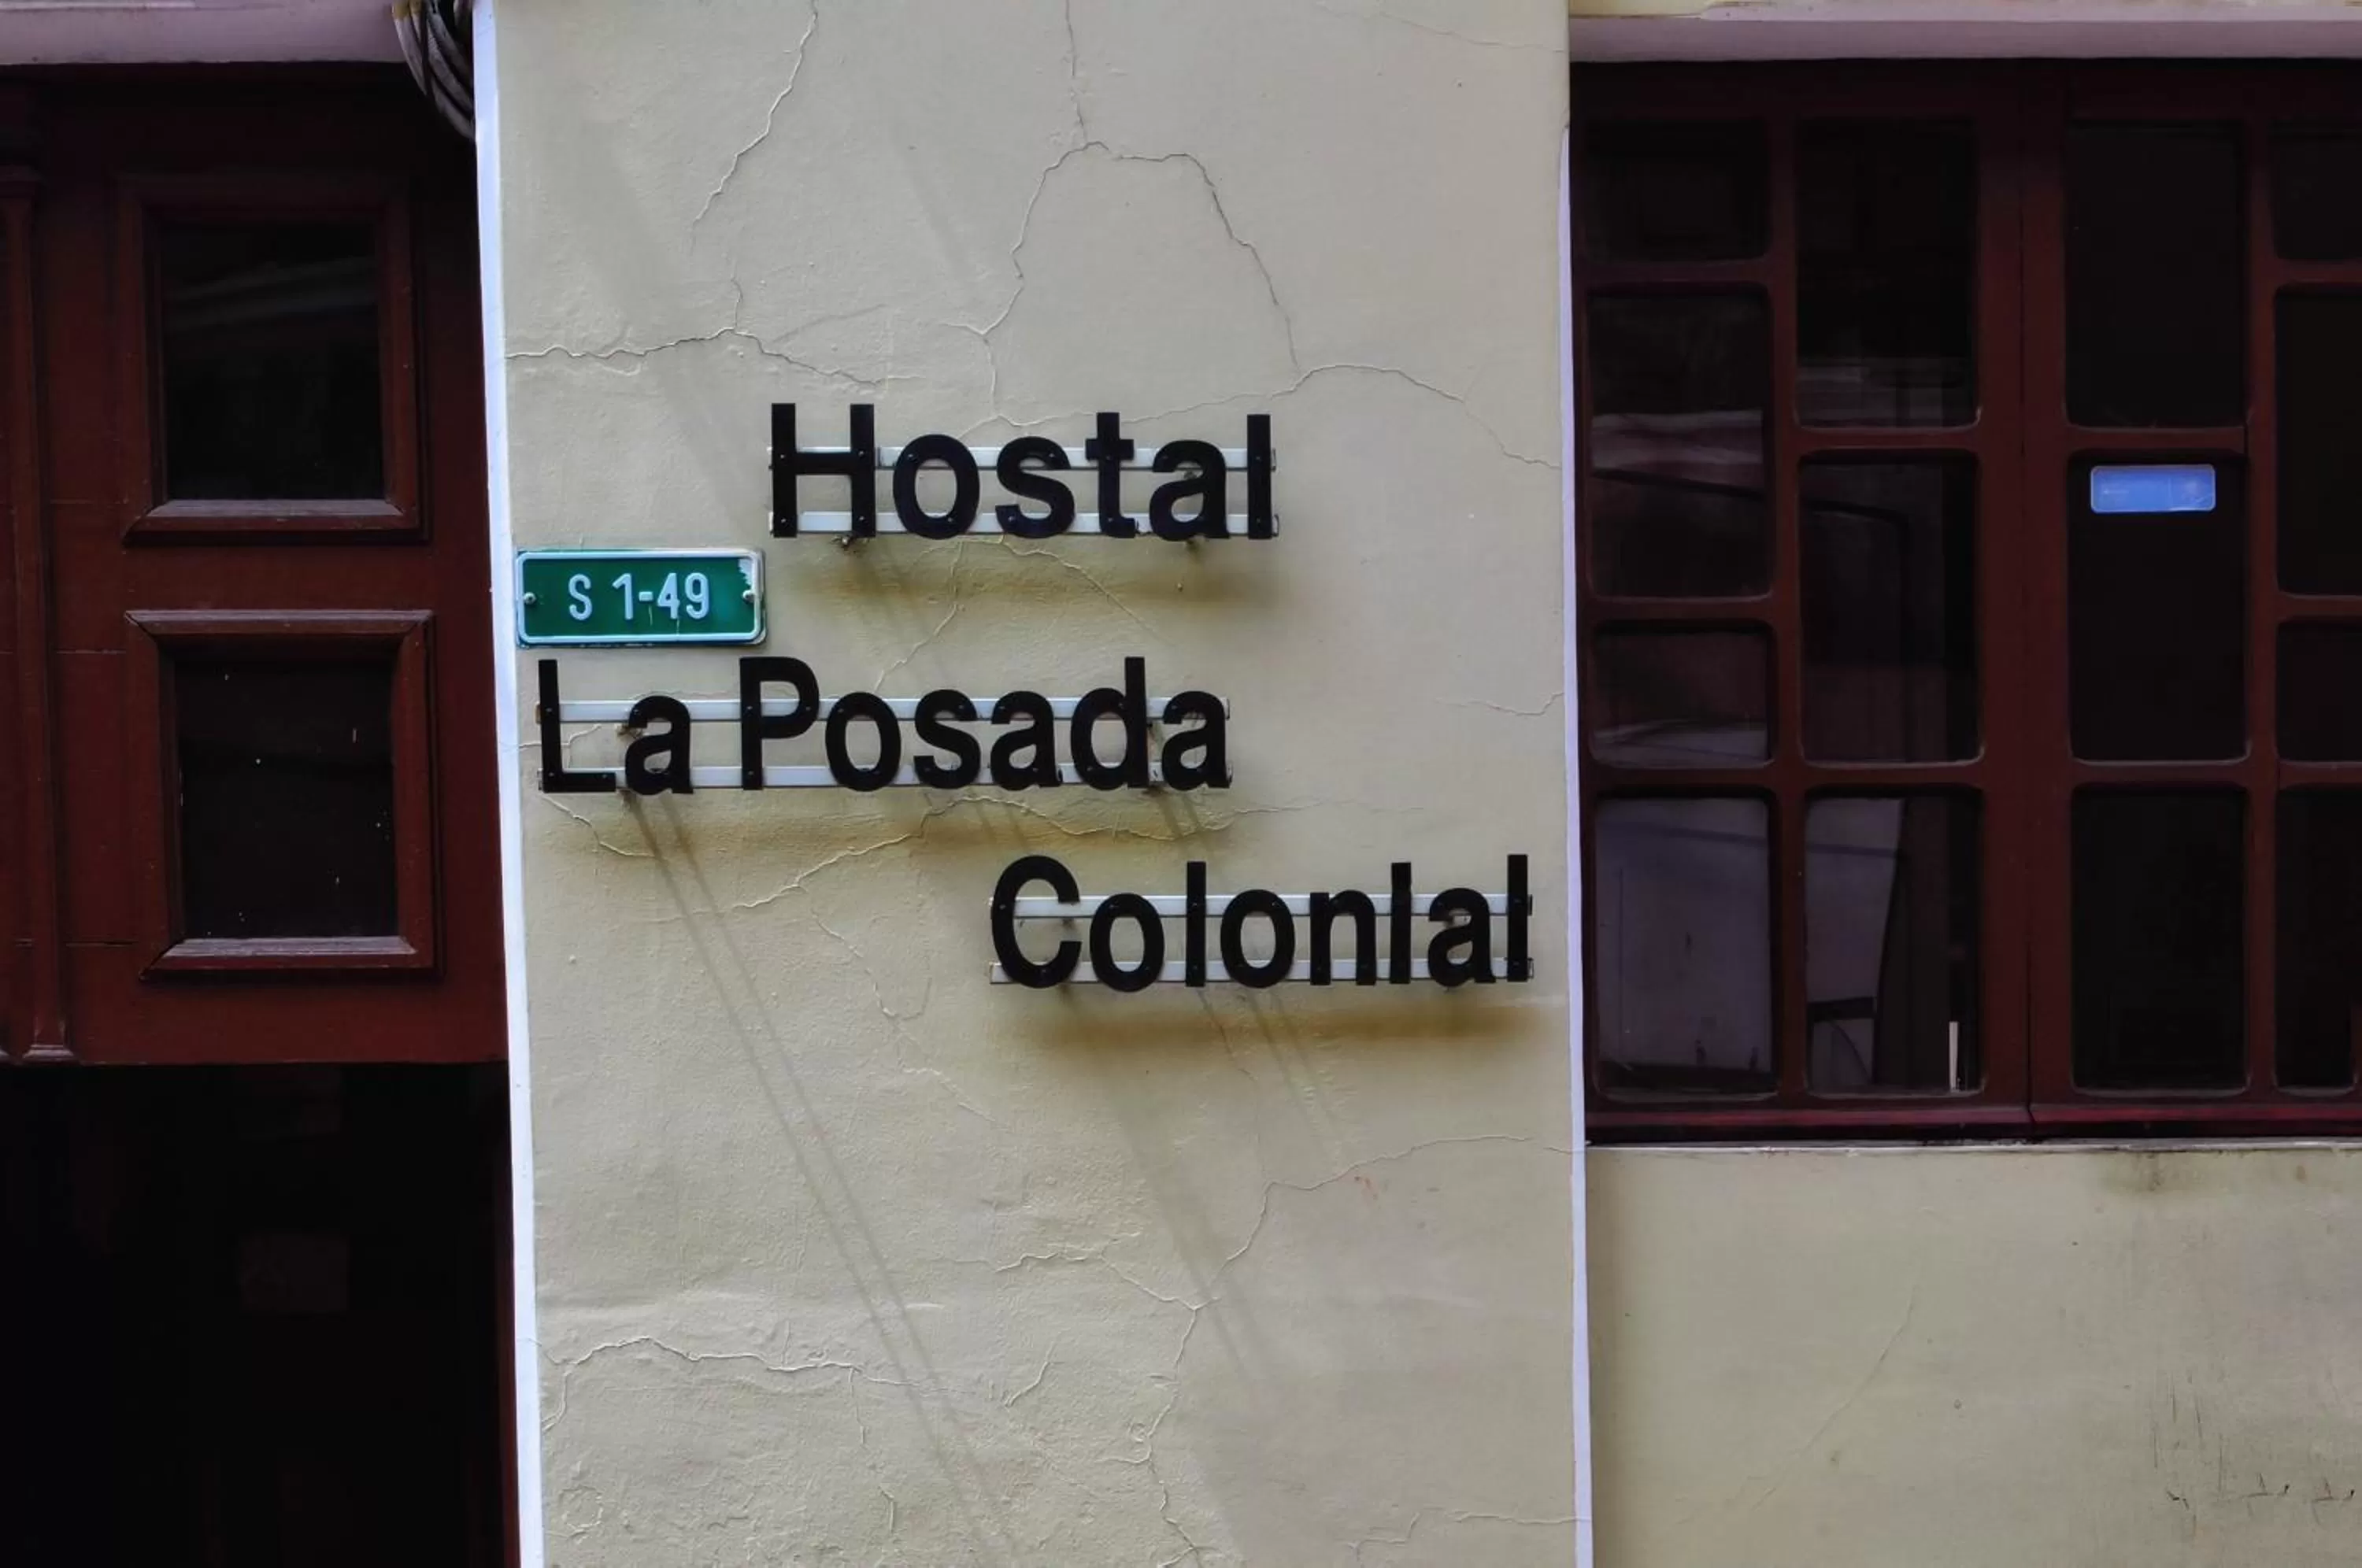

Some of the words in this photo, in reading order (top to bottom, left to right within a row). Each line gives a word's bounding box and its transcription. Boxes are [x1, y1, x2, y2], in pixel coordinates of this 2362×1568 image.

[771, 403, 1272, 540] Hostal
[568, 573, 593, 620] S
[612, 572, 709, 620] 1-49
[538, 659, 693, 795] La
[739, 656, 1231, 792] Posada
[990, 854, 1529, 993] Colonial
